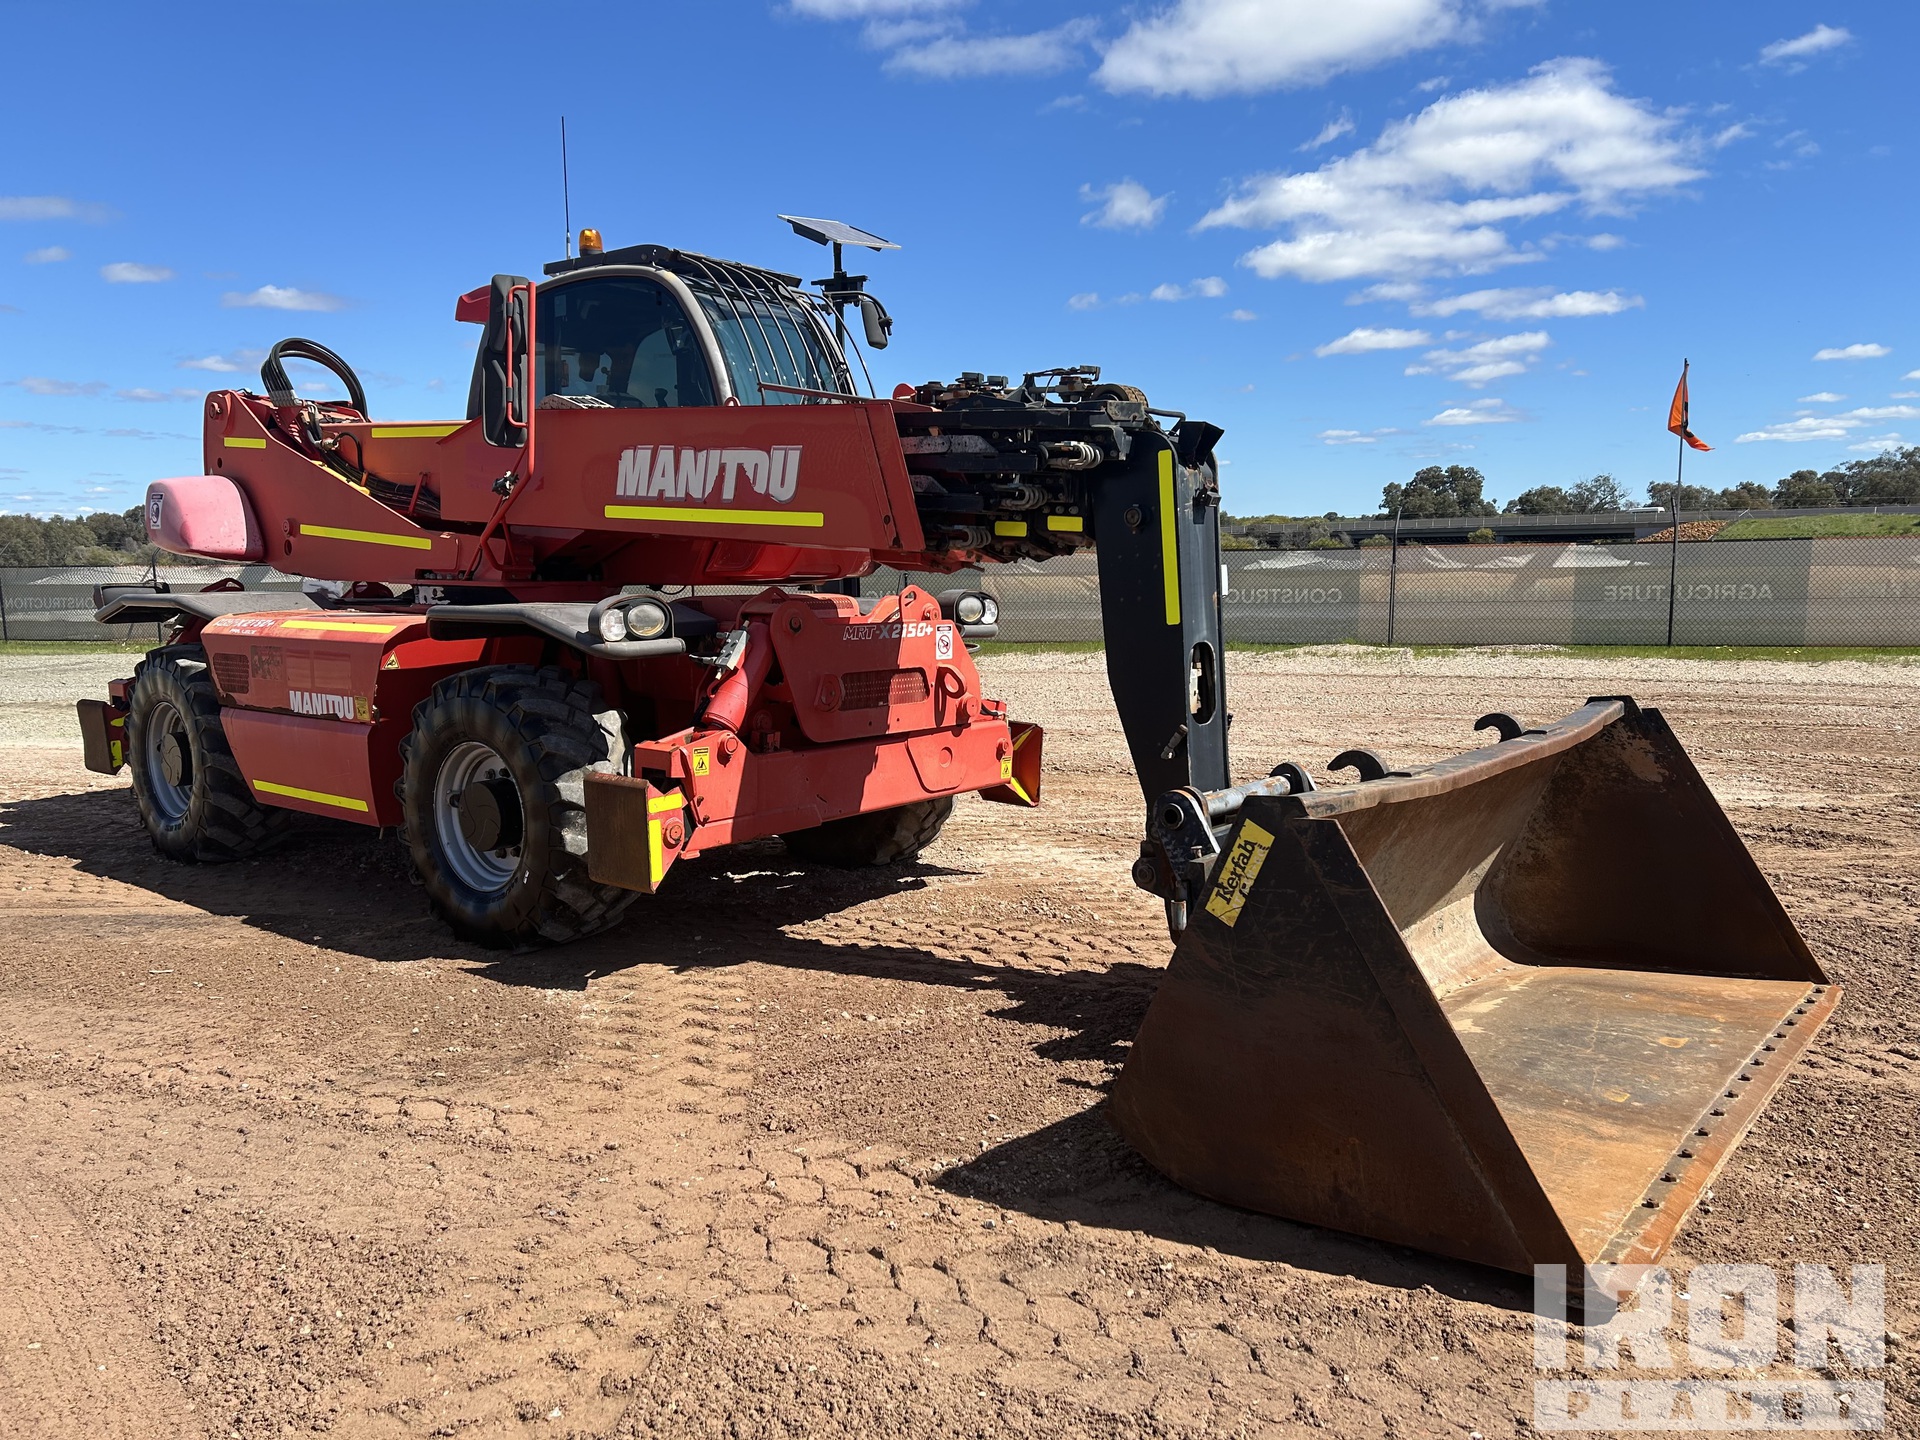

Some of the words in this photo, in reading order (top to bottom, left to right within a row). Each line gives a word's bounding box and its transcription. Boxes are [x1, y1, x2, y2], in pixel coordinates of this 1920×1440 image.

[615, 445, 803, 503] MANITOU
[289, 690, 354, 720] MANITOU
[1215, 839, 1258, 905] Kerfab
